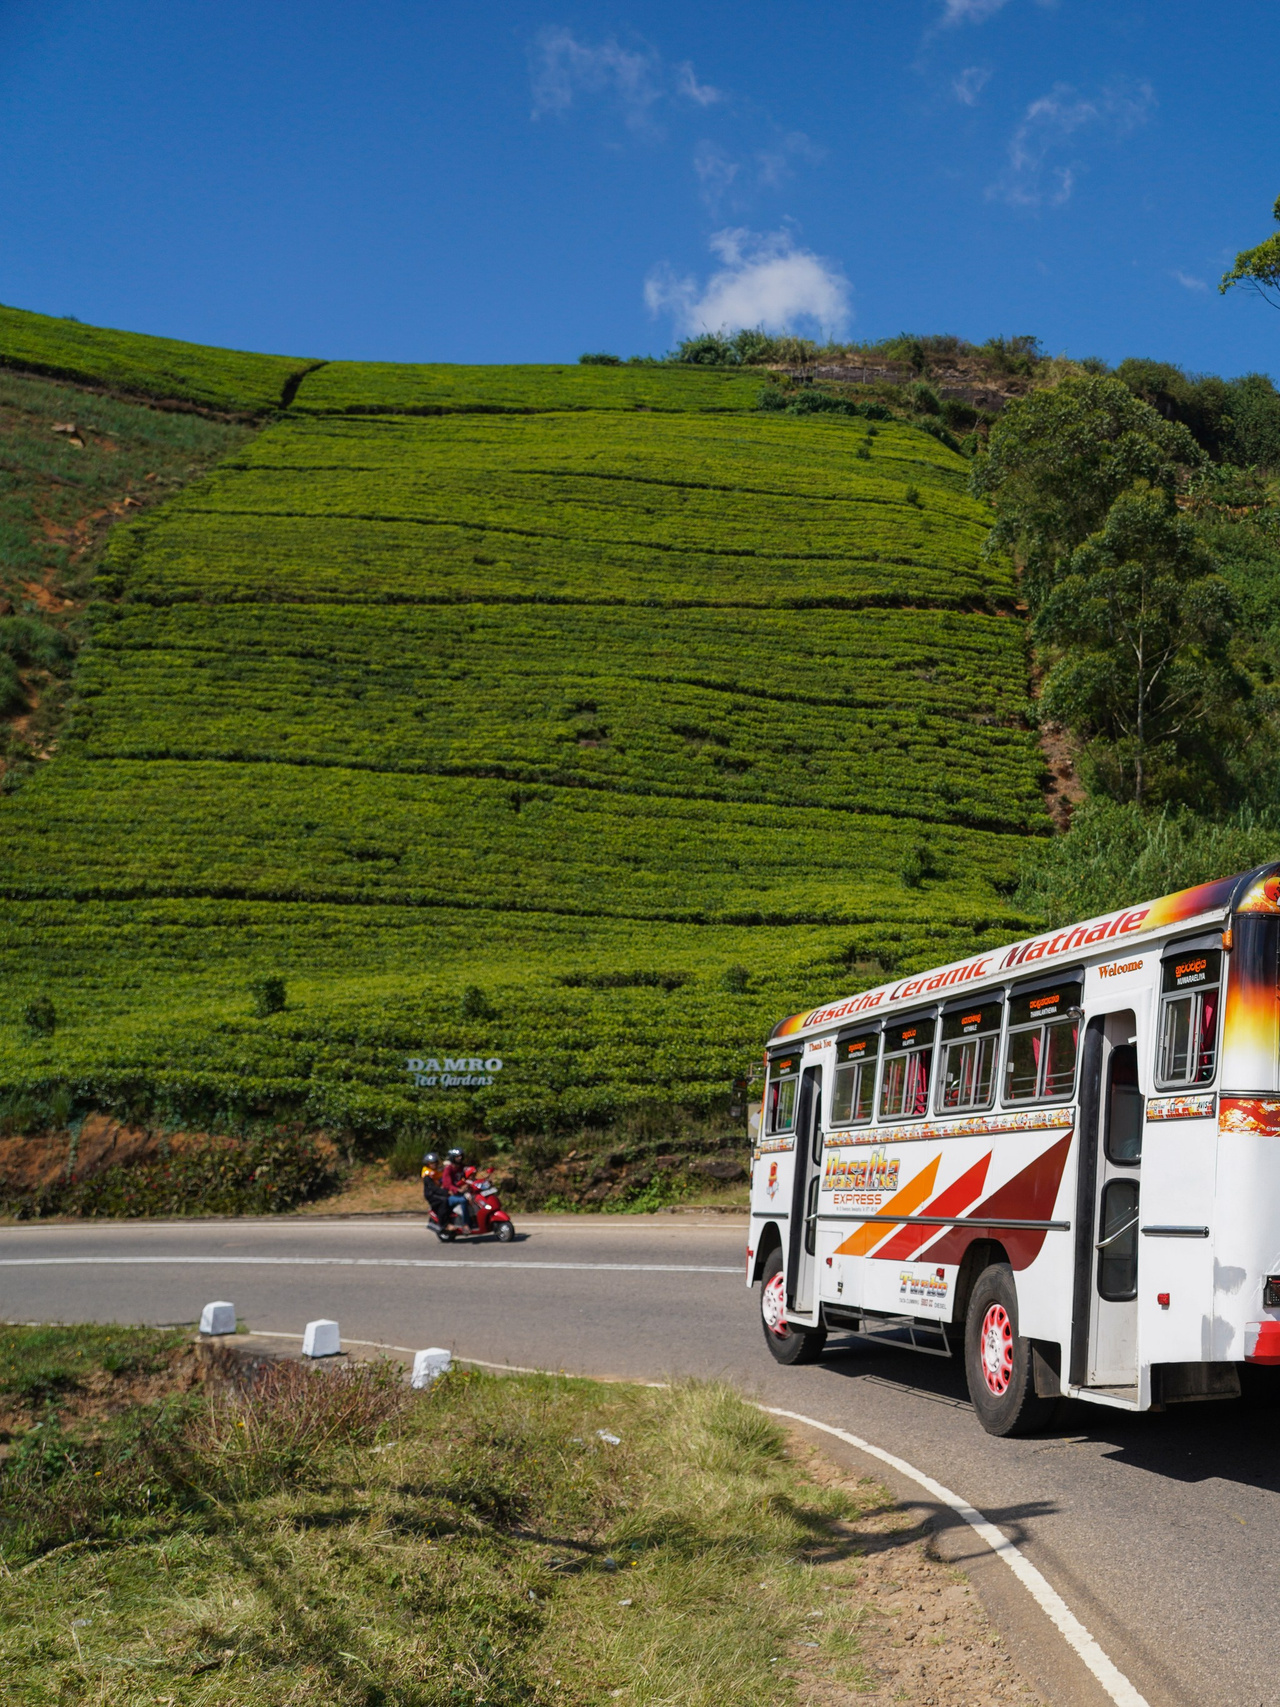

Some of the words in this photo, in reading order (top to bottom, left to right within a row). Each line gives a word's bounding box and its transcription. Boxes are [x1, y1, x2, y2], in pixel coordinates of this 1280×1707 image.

[802, 991, 885, 1028] Dasatha
[890, 957, 994, 1001] Ceramic
[999, 909, 1150, 970] Mathale
[1098, 959, 1144, 979] Welcome
[809, 1043, 822, 1052] Thank
[823, 1039, 832, 1048] You
[407, 1058, 503, 1071] DAMRO
[414, 1073, 437, 1087] Tea
[440, 1073, 494, 1090] Gardens
[823, 1145, 900, 1191] Dasatha
[833, 1194, 882, 1205] EXPRESS
[899, 1270, 948, 1298] Turbo
